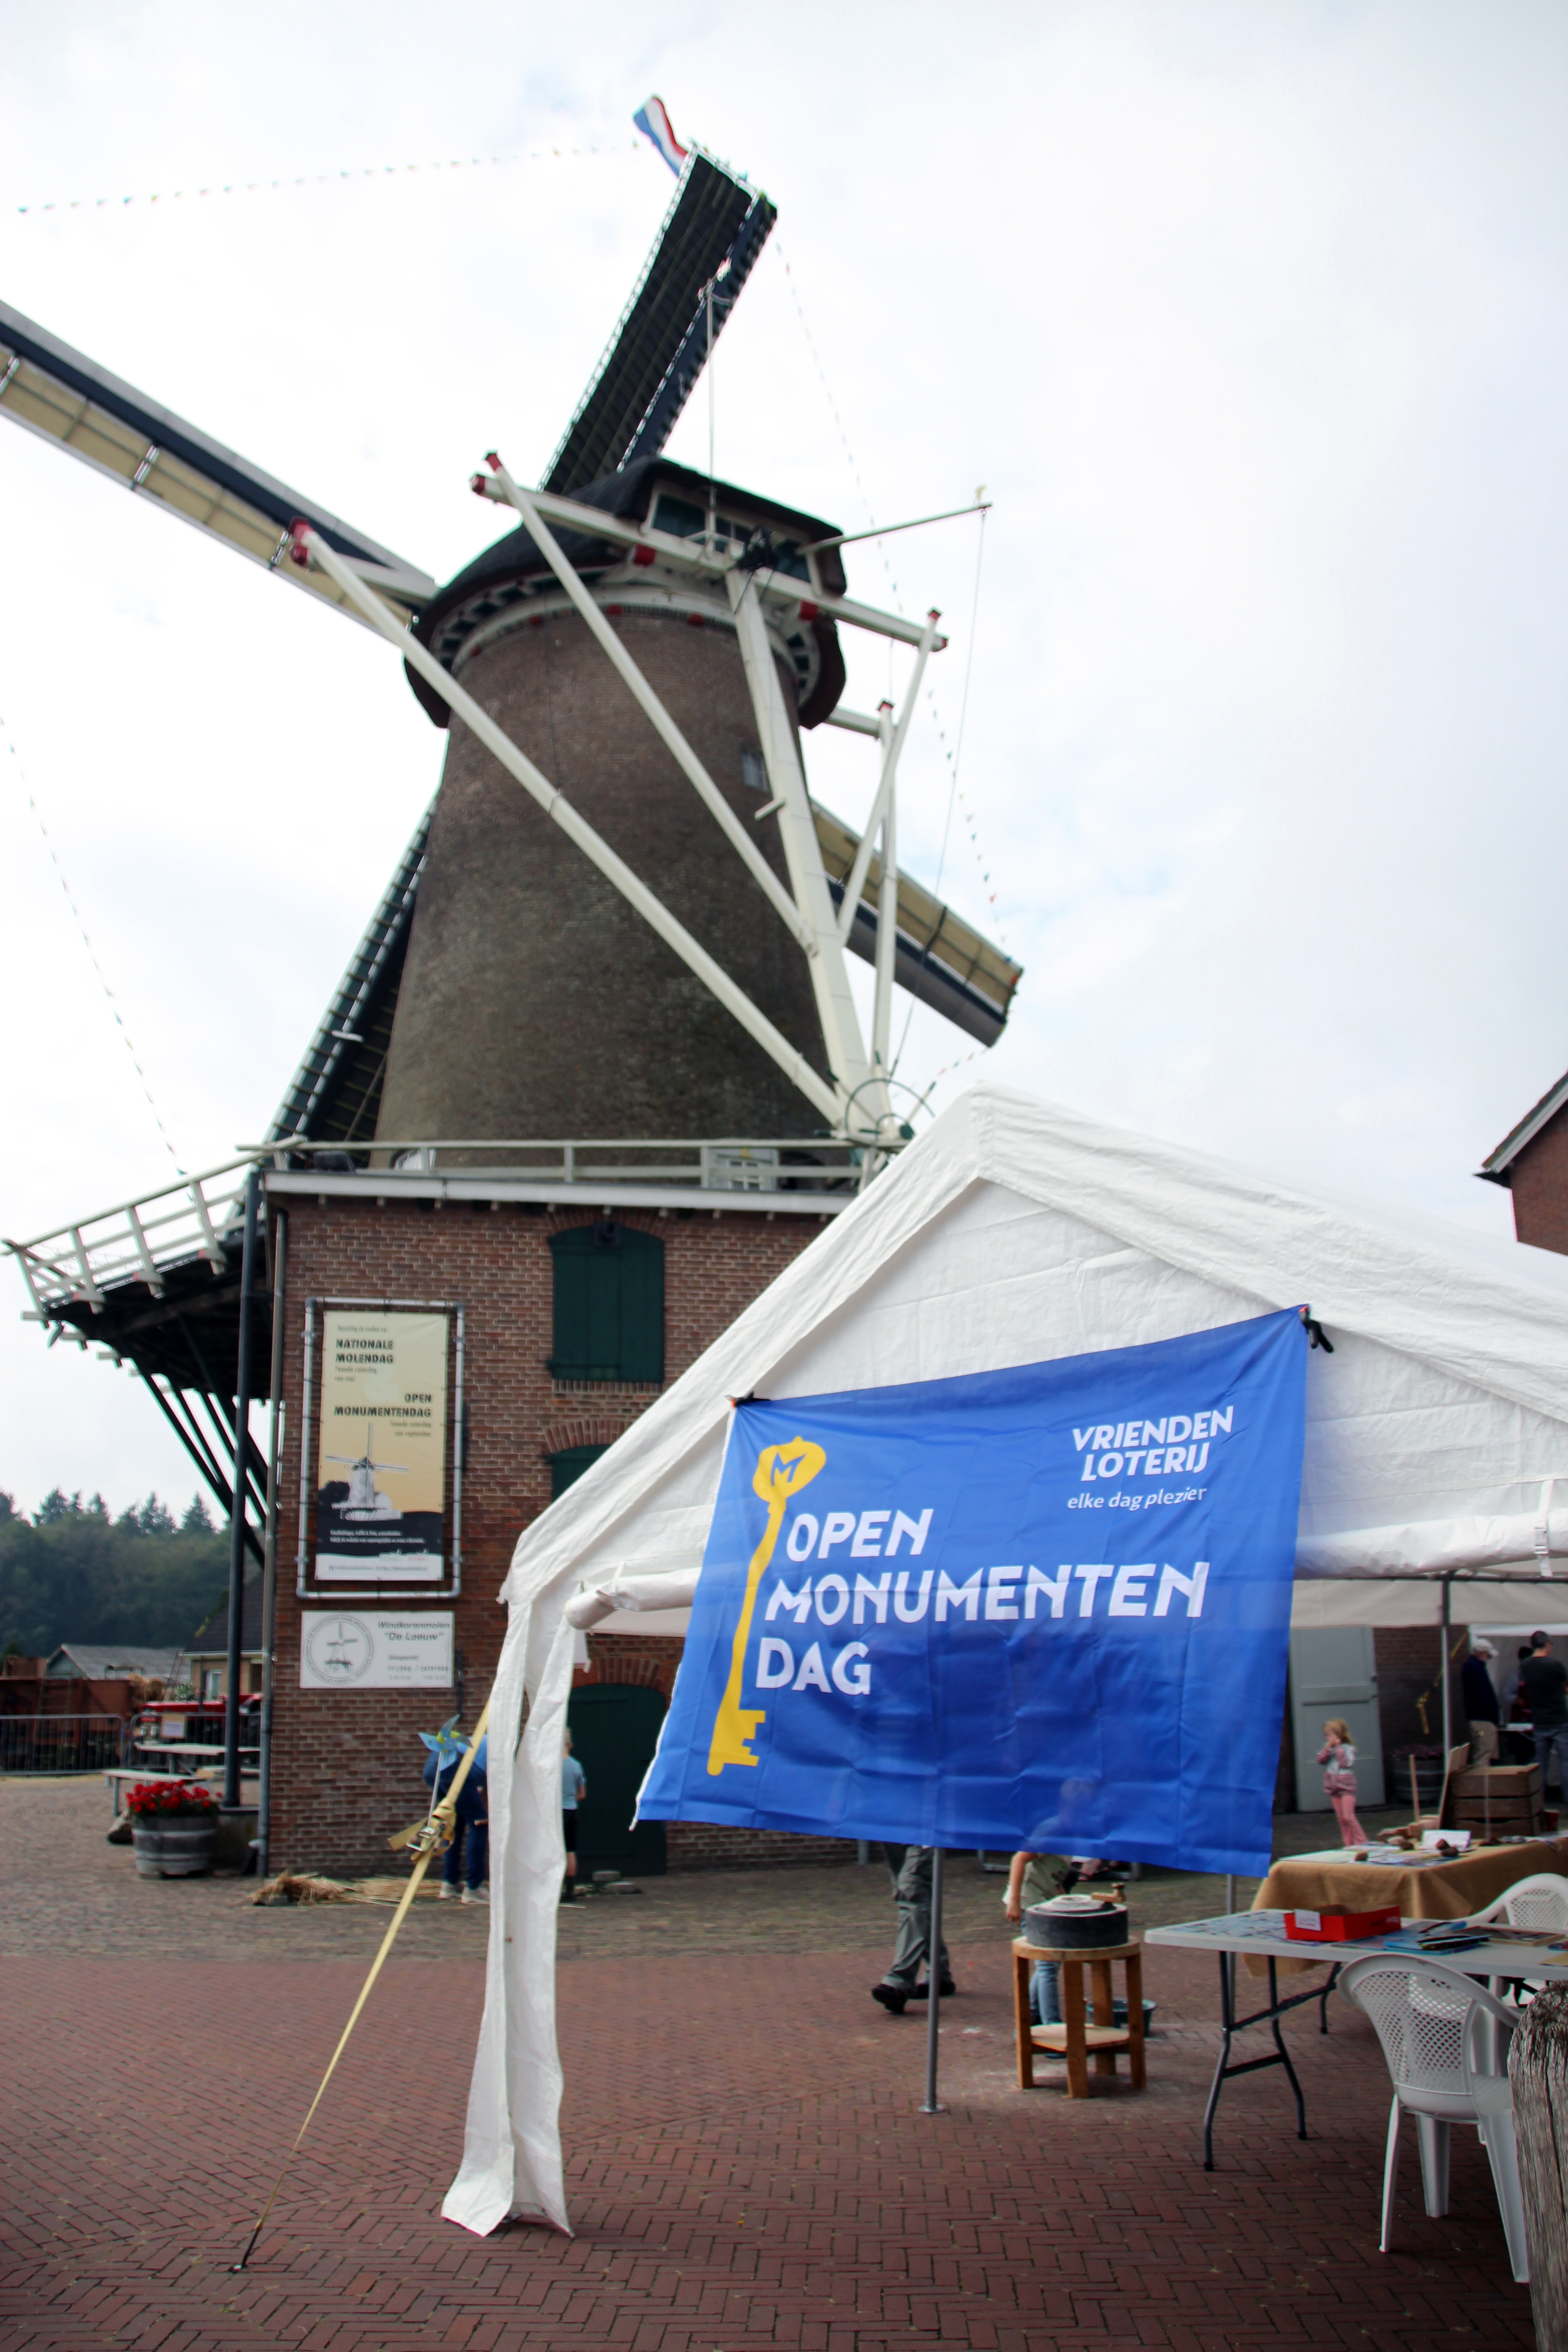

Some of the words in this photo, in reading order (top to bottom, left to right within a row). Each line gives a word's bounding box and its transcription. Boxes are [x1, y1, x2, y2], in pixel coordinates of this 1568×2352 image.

[336, 1339, 393, 1349] NATIONALE
[335, 1353, 393, 1363] MOLENDAG
[355, 1366, 377, 1374] zaterdag
[404, 1393, 431, 1403] OPEN
[333, 1406, 431, 1417] MONUMENTENDAG
[1073, 1406, 1234, 1451] VRIENDEN
[1081, 1442, 1210, 1481] LOTERIJ
[1067, 1493, 1104, 1509] elke
[1108, 1492, 1144, 1511] dag
[1144, 1487, 1207, 1509] plezier
[786, 1508, 934, 1562] OPEN
[765, 1562, 1210, 1626] MONUMENTEN
[385, 1632, 402, 1641] "De
[405, 1632, 443, 1641] Leeuw"
[755, 1637, 872, 1695] DAG
